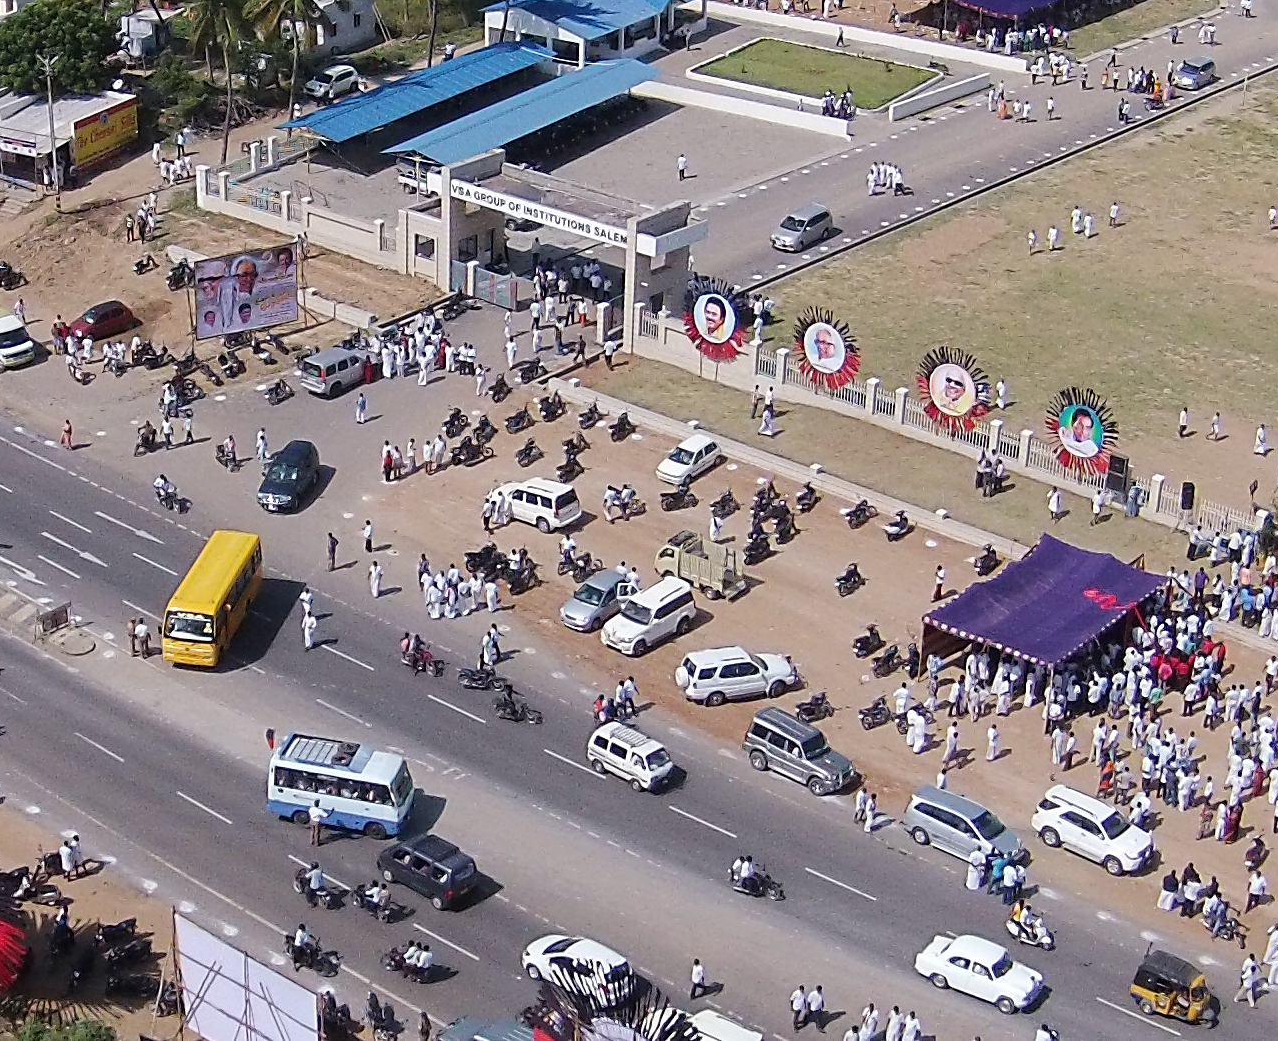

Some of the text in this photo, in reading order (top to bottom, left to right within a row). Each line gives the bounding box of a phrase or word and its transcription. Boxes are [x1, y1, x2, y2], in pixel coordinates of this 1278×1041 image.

[452, 183, 628, 244] VSA GROUP OF INSTITUTIONS SALEM
